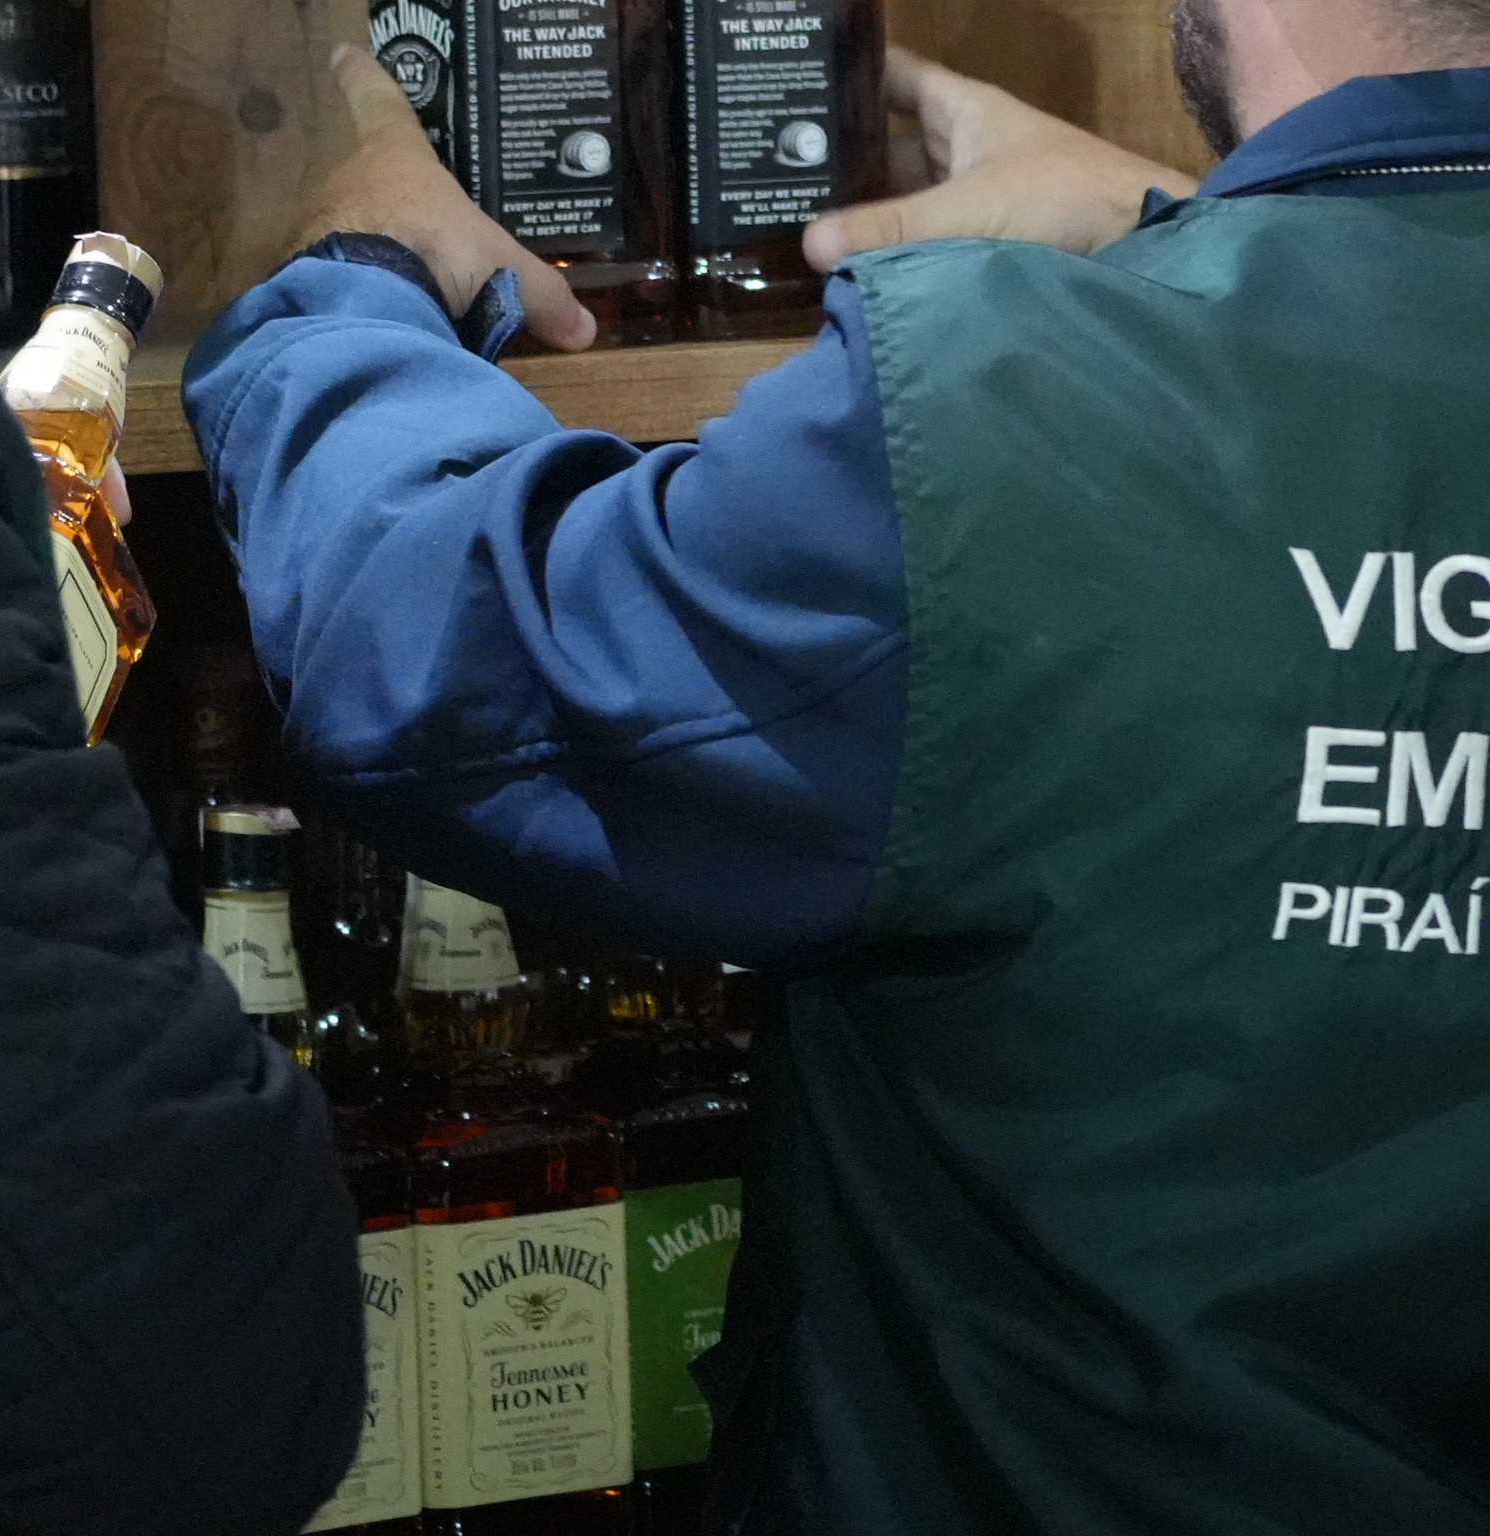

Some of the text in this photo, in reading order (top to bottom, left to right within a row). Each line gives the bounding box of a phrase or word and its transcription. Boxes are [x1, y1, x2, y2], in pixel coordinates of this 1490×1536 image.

[502, 24, 606, 43] THE WAY JACK
[719, 16, 823, 35] THE WAY JACK
[516, 43, 593, 61] INTENDED
[733, 35, 810, 52] INTENDED
[1297, 725, 1490, 831] EM
[647, 1214, 711, 1272] JACK
[456, 1239, 613, 1309] JACK DANIEL'S
[489, 1361, 589, 1389] Tennessee
[490, 1381, 592, 1413] HONEY
